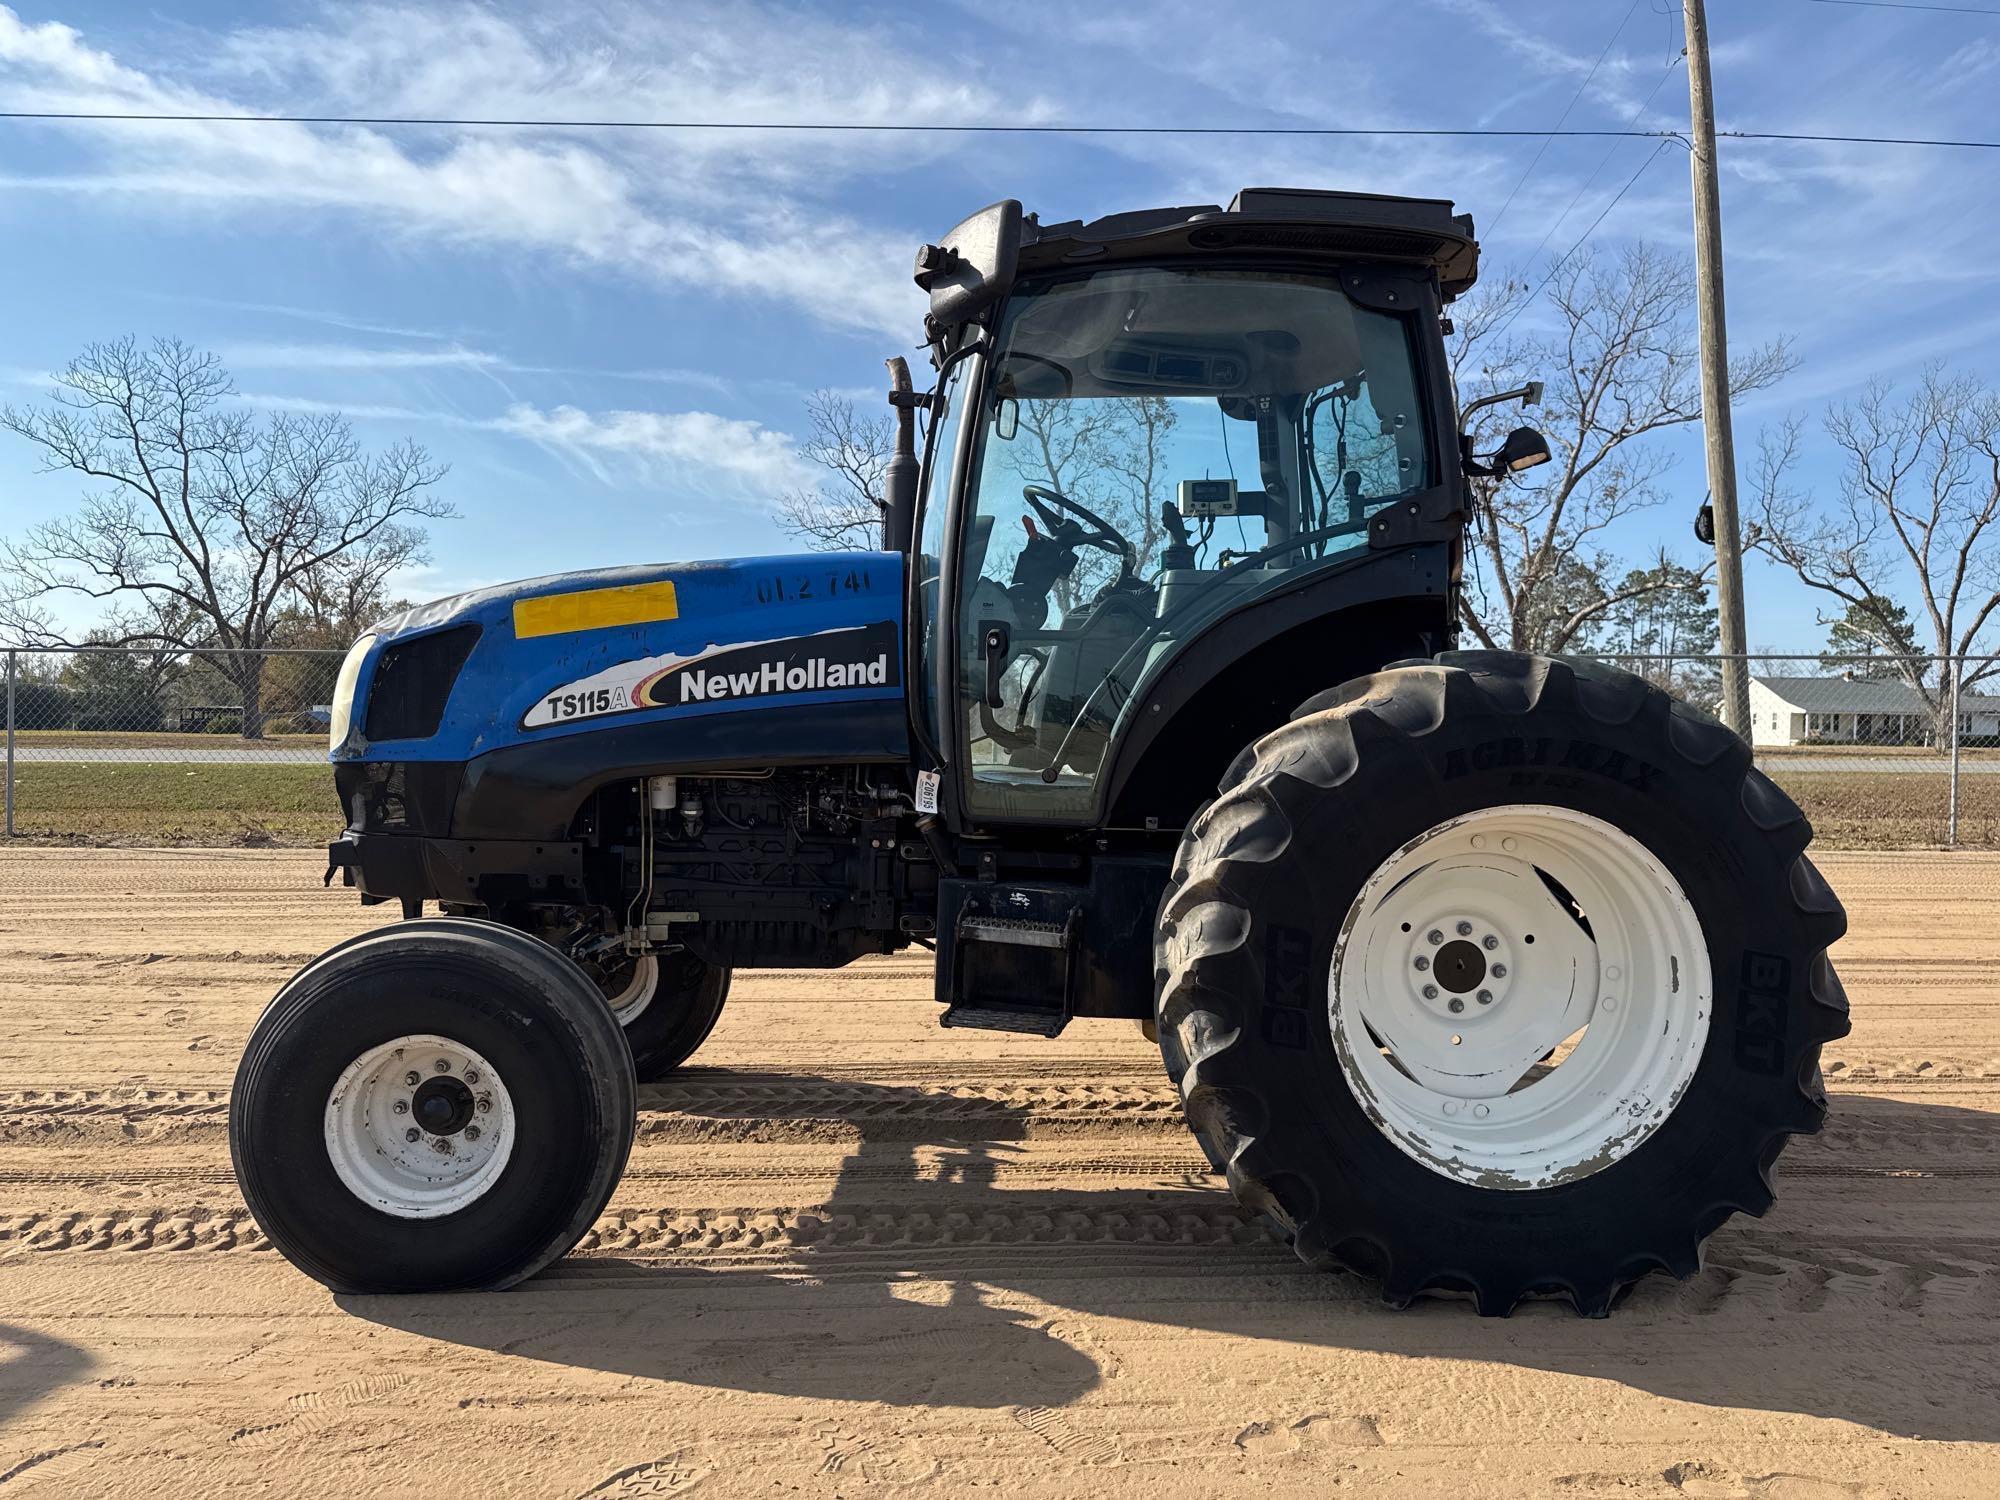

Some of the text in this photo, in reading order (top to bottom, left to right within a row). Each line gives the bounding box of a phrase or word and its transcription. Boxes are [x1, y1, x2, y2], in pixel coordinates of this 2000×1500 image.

[548, 687, 628, 719] TS115A
[680, 653, 887, 702] NewHolland
[1558, 739, 1665, 792] MAX
[923, 781, 935, 809] 206195
[1270, 927, 1309, 1045] BKT
[1740, 952, 1787, 1072] BKT
